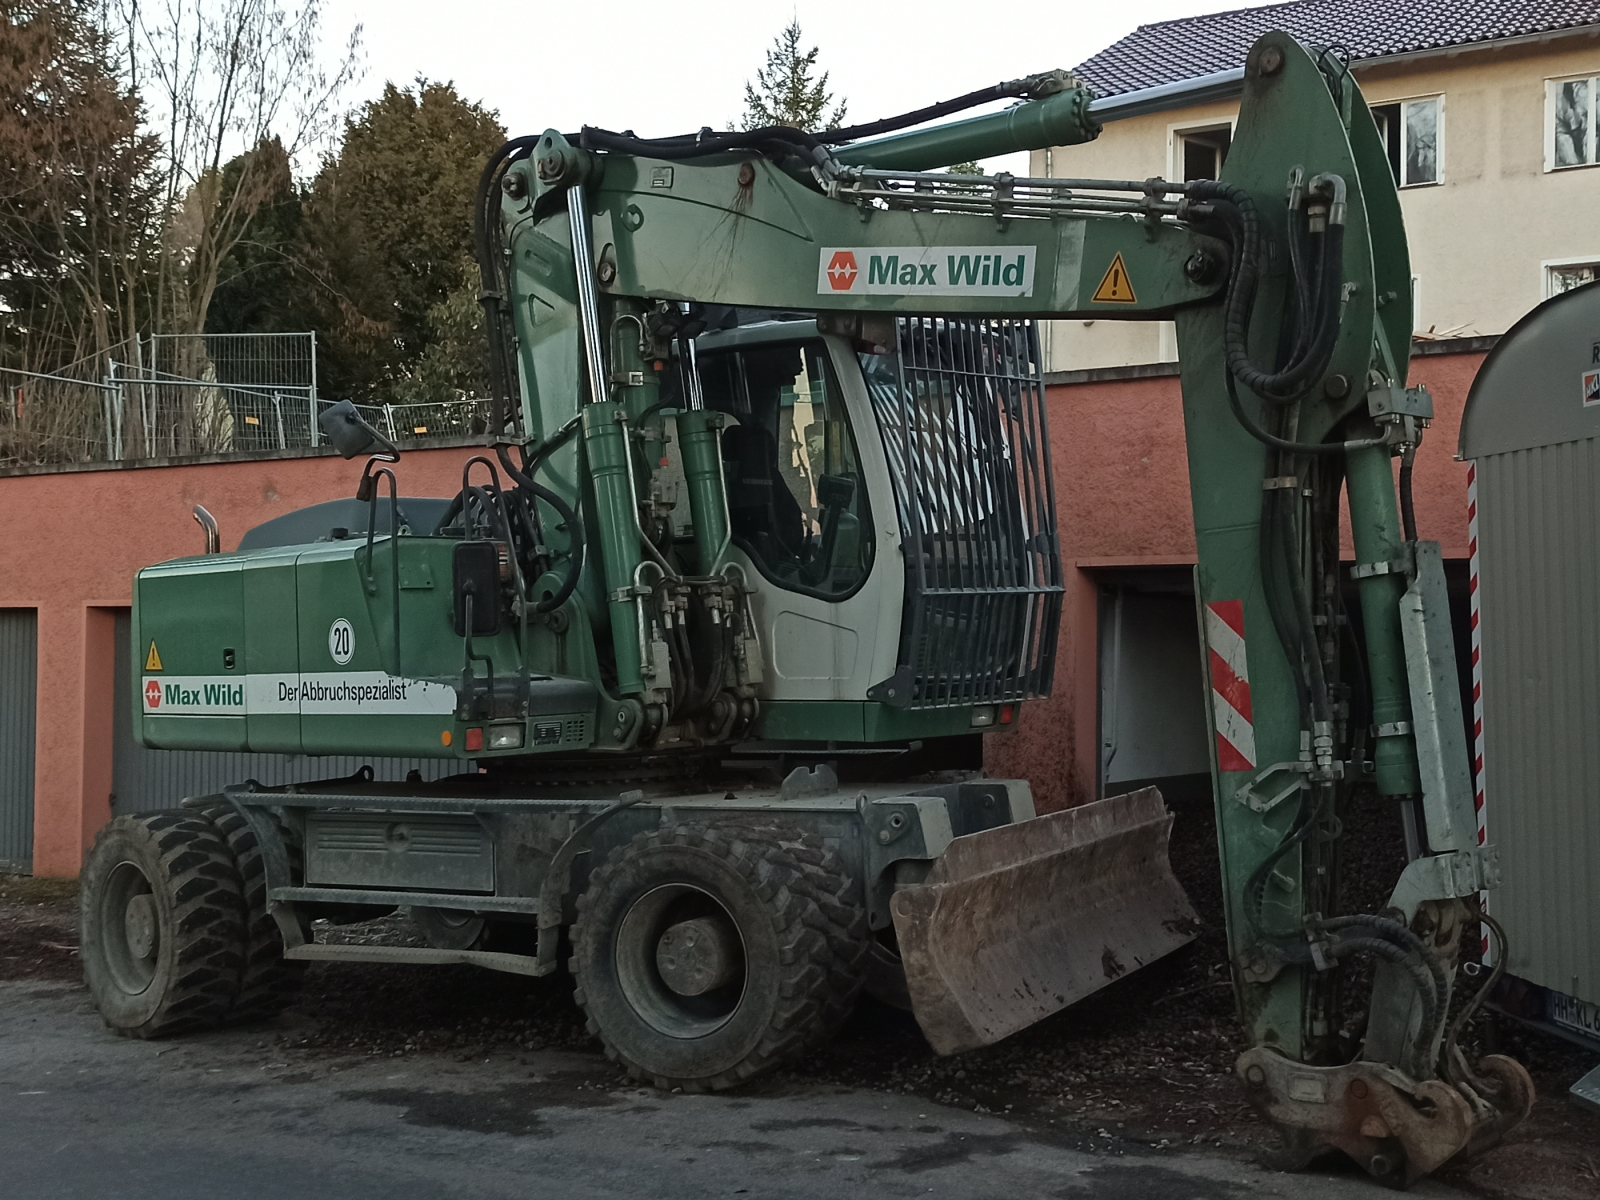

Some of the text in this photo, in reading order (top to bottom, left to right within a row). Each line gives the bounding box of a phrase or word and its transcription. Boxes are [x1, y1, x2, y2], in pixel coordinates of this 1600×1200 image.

[868, 254, 1026, 287] Max Wild
[334, 627, 350, 656] 20
[165, 684, 244, 706] Max Wild
[278, 679, 407, 706] Der Abbruchspezialist
[1553, 994, 1569, 1021] HH
[1576, 1003, 1592, 1030] KL
